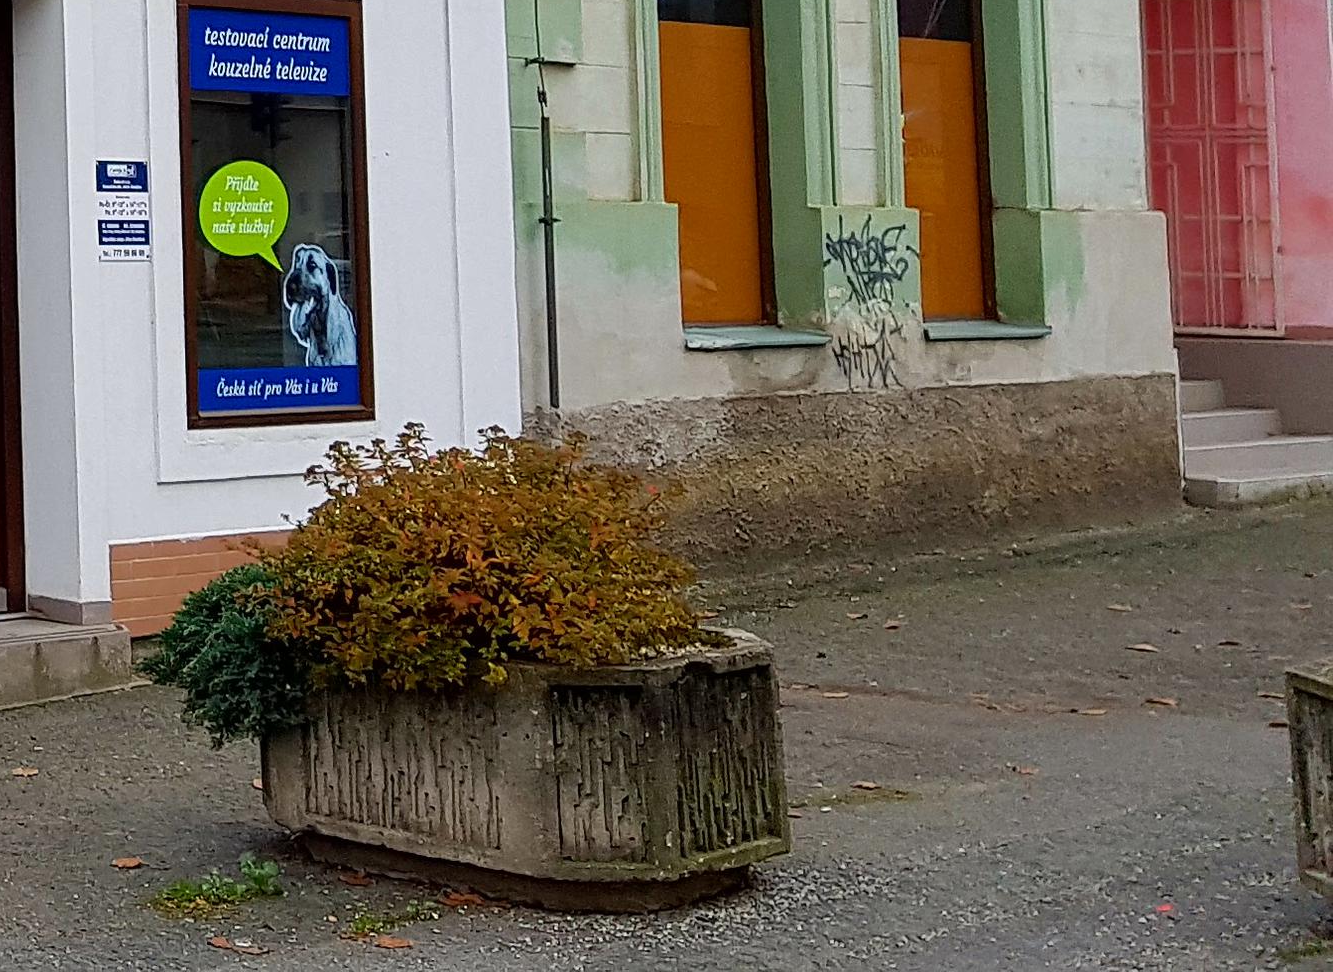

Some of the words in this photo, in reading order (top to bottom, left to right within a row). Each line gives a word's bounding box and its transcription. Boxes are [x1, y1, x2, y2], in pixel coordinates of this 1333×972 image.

[204, 26, 270, 48] testovací
[273, 32, 330, 52] centrum
[208, 52, 271, 79] kouzelné
[275, 57, 328, 82] televize
[212, 196, 222, 212] si
[224, 195, 273, 217] vyzkoušet
[212, 219, 236, 234] naše
[238, 217, 275, 239] služby!
[216, 377, 245, 397] Česká
[248, 378, 264, 396] síť
[263, 383, 282, 400] pro
[284, 377, 303, 395] Vás
[304, 378, 310, 394] i
[311, 382, 319, 394] u
[321, 376, 338, 393] Vás
